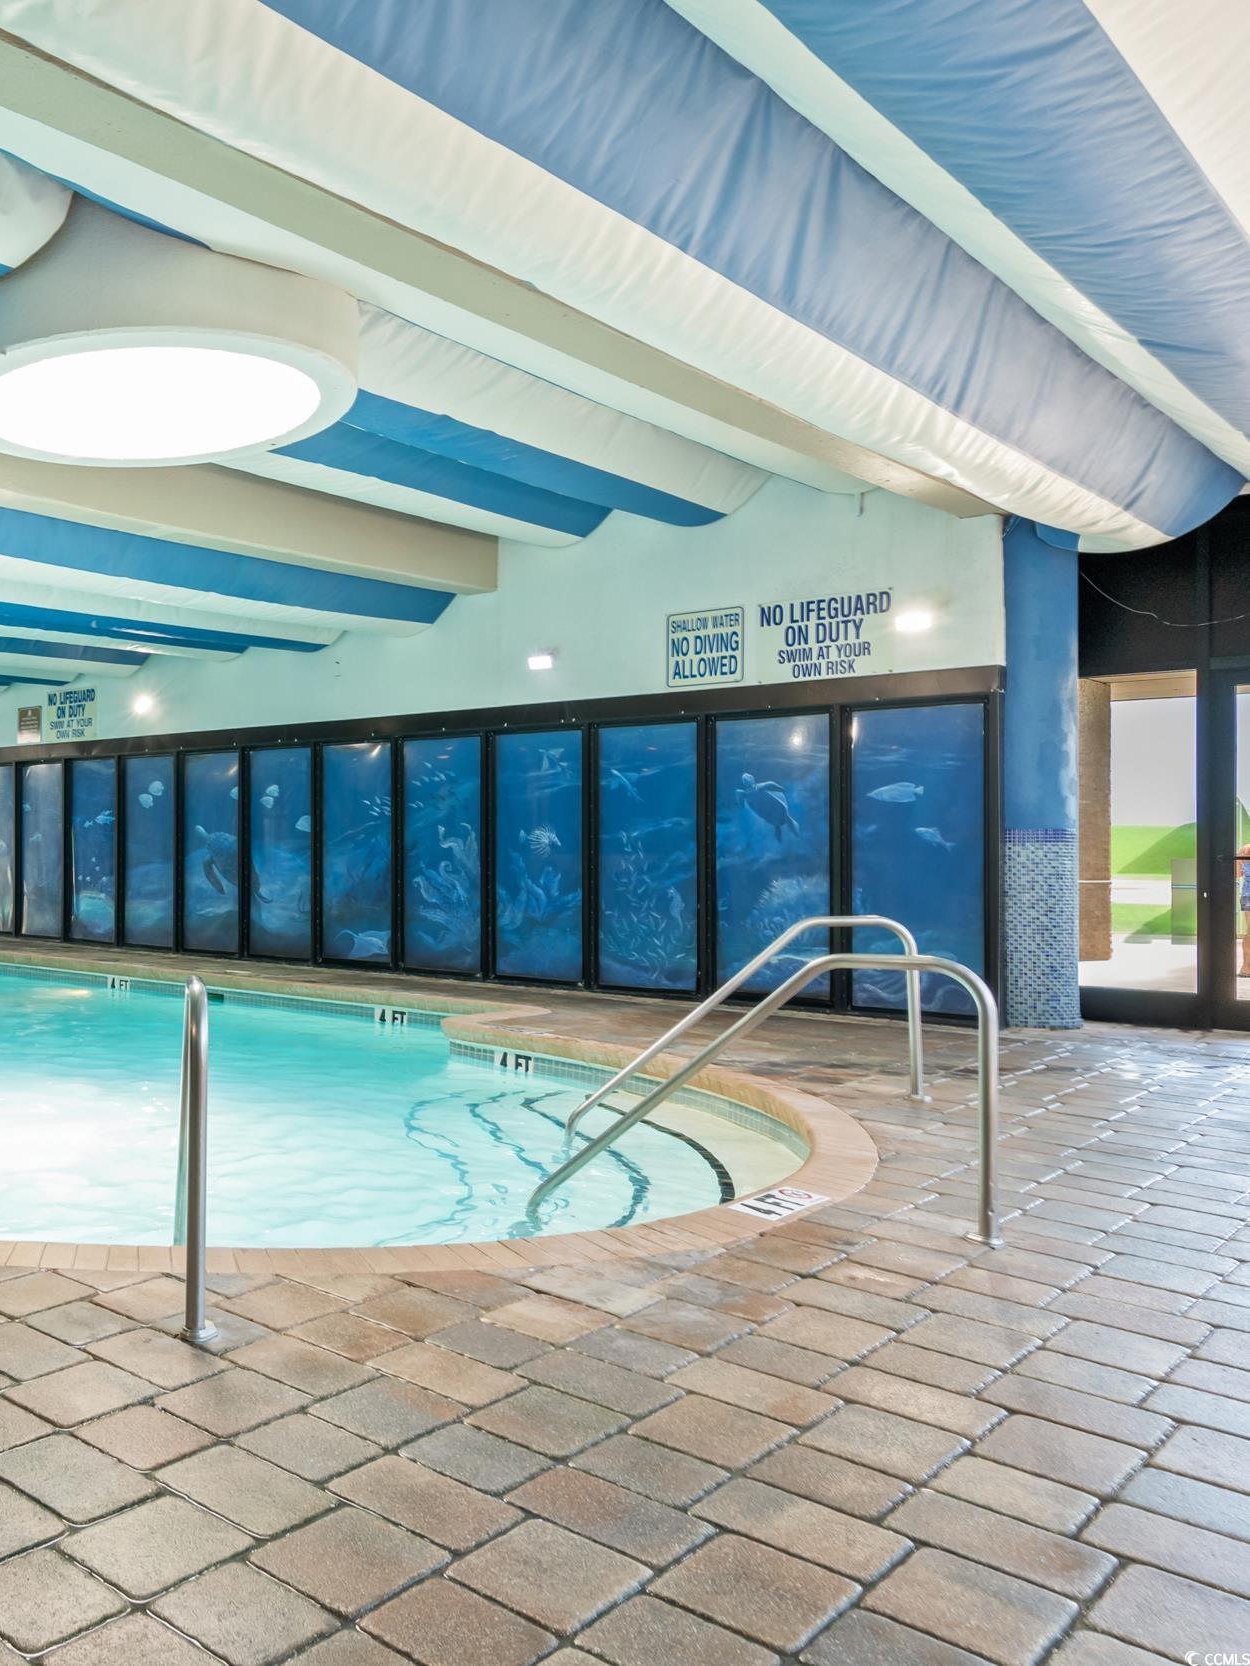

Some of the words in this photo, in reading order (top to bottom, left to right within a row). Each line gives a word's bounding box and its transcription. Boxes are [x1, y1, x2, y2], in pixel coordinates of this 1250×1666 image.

[760, 605, 784, 627] NO
[790, 590, 892, 623] LIFEGUARD
[670, 615, 709, 634] SHALLOW
[712, 613, 740, 629] WATER
[785, 626, 809, 647] ON
[815, 618, 864, 644] DUTY
[670, 637, 690, 657] NO
[694, 631, 739, 654] DIVING
[778, 647, 813, 665] SWIM
[816, 646, 830, 661] AT
[835, 641, 871, 659] YOUR
[672, 655, 738, 680] ALLOWED
[792, 662, 822, 678] OWN
[826, 659, 856, 676] RISK
[48, 693, 57, 706] NO
[59, 688, 95, 704] LIFEGUARD
[56, 706, 66, 719] ON
[68, 704, 86, 717] DUTY
[50, 721, 64, 730] SWIM
[67, 720, 74, 728] AT
[76, 717, 93, 727] YOUR
[56, 730, 69, 739] OWN
[71, 729, 85, 738] RISK
[110, 977, 115, 989] 4
[119, 979, 129, 990] FT
[379, 1009, 386, 1022] 4
[391, 1010, 406, 1025] FT
[500, 1051, 507, 1068] 4
[514, 1054, 532, 1073] FT
[740, 1203, 783, 1216] 4
[753, 1193, 805, 1211] FT
